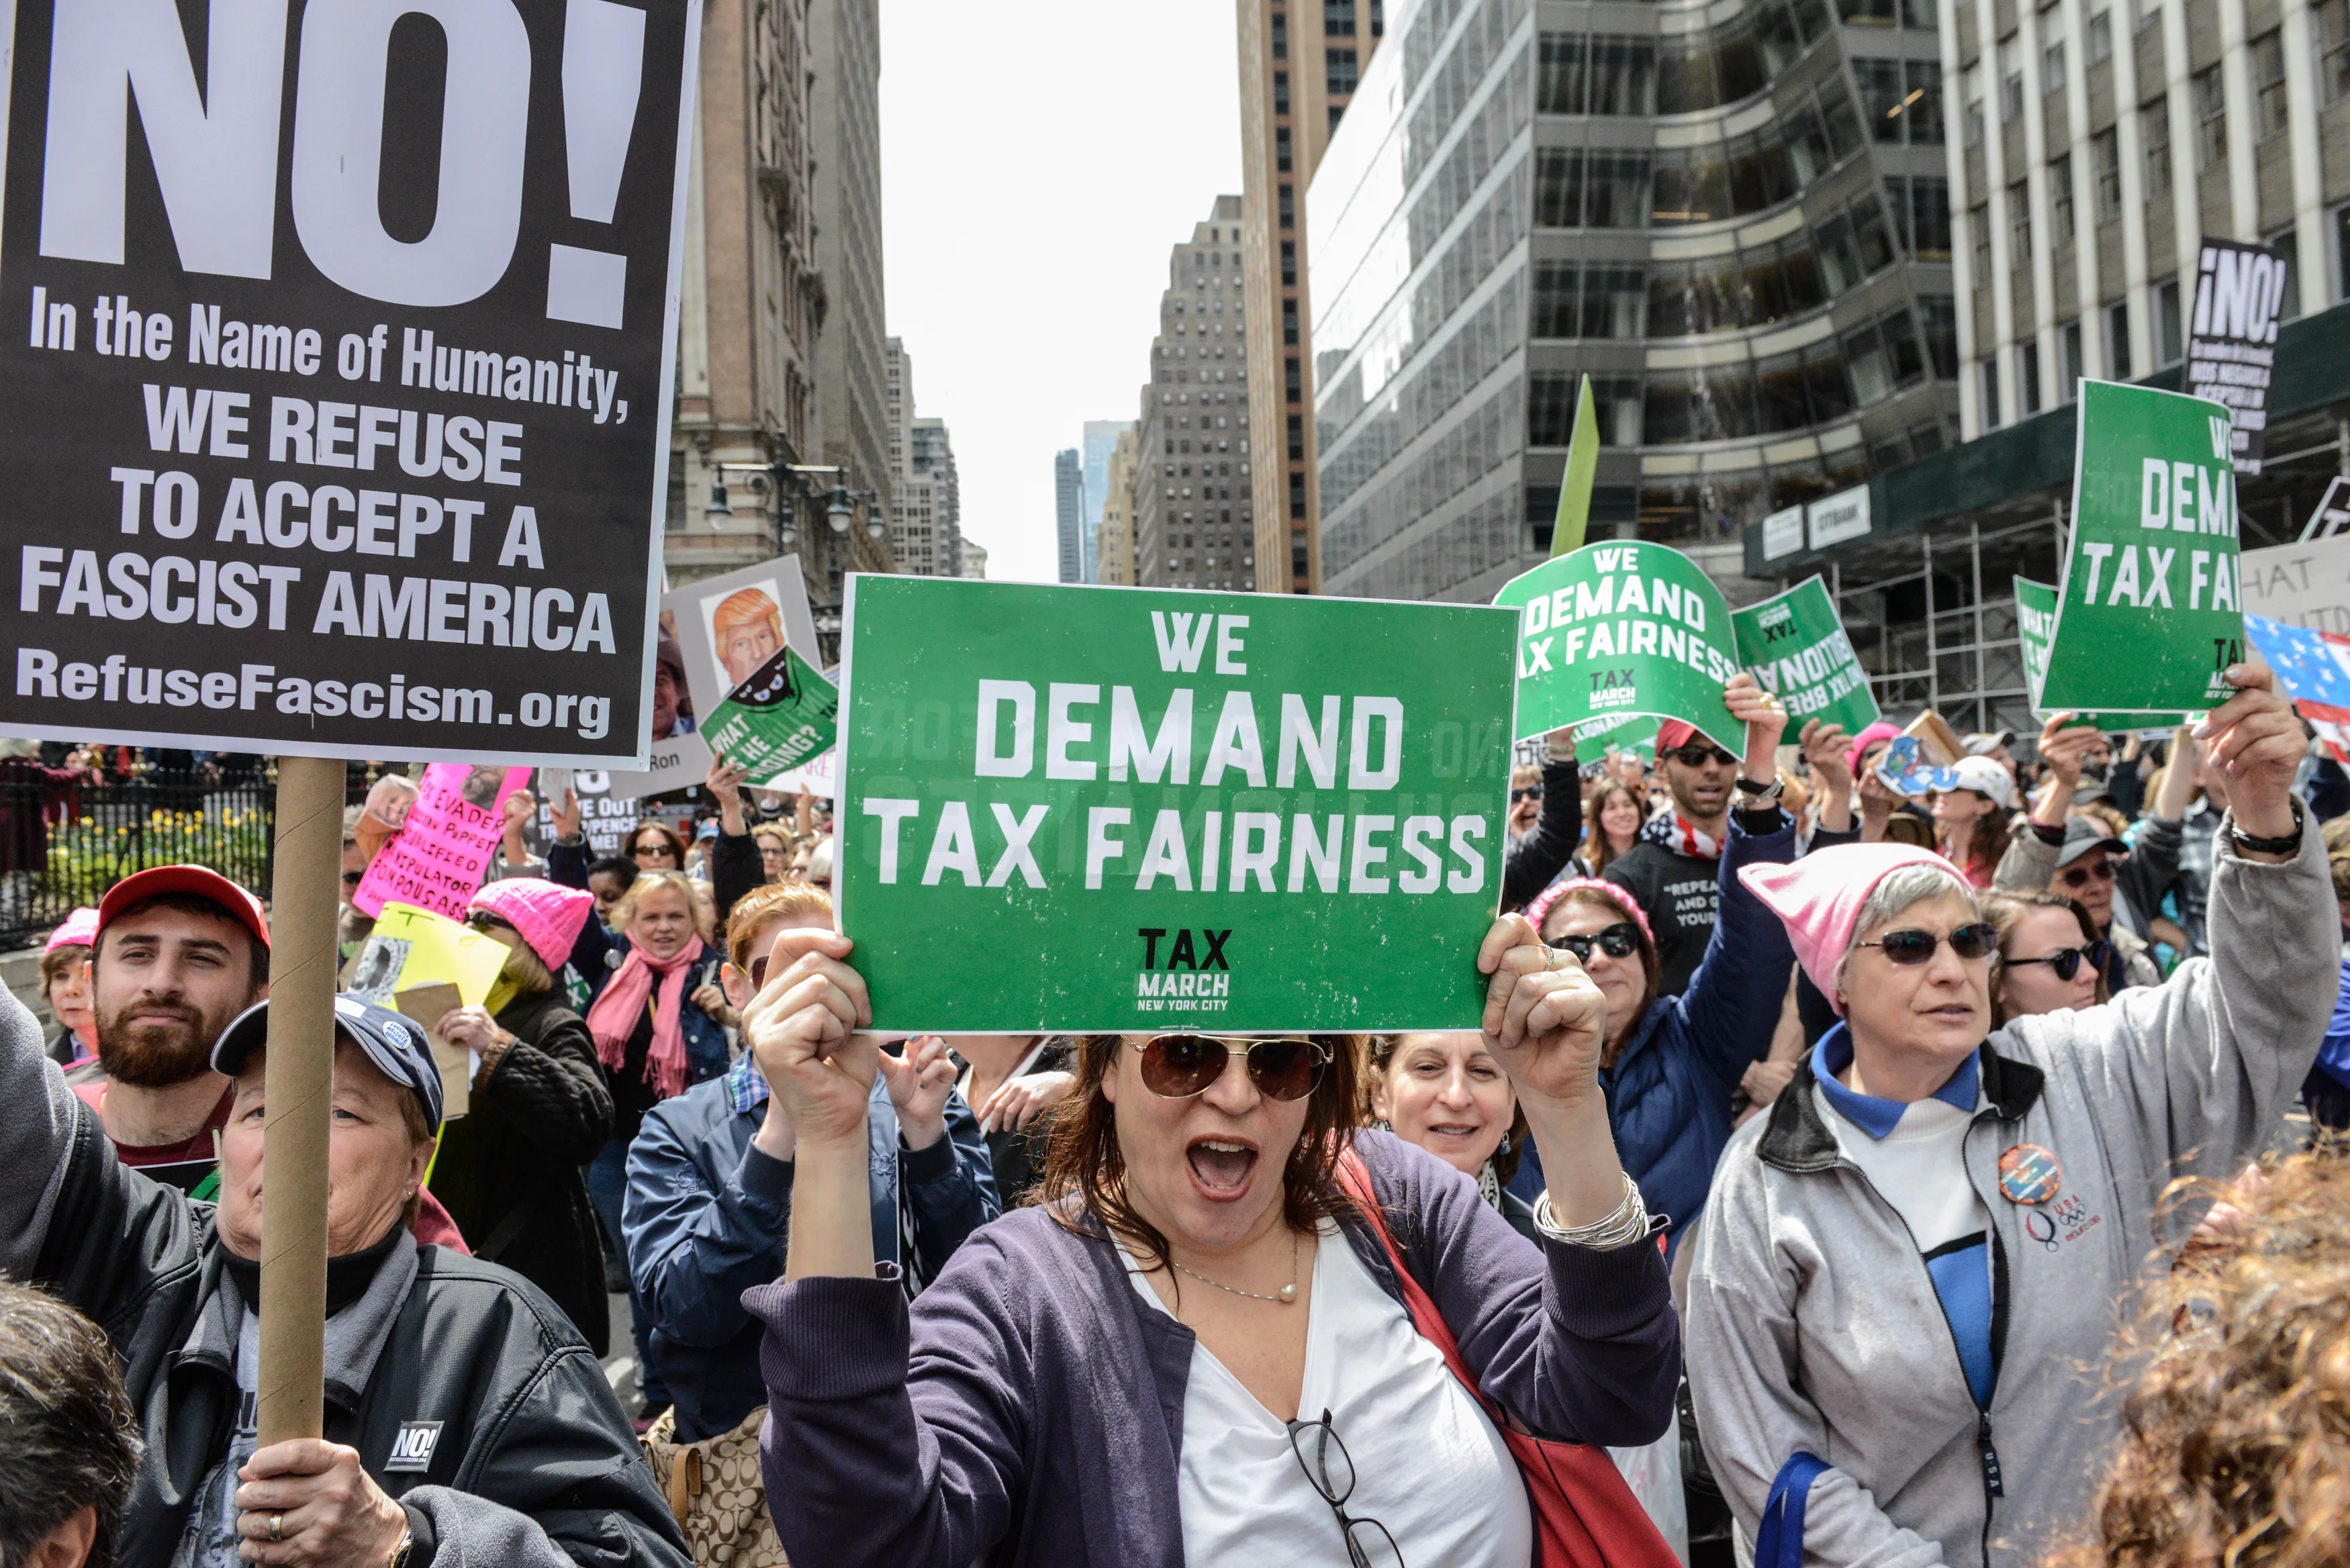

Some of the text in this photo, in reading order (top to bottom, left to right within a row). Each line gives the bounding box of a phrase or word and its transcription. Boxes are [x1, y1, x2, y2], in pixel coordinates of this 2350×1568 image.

[39, 0, 646, 330] NO!
[2193, 246, 2286, 344] ¡NO!
[30, 287, 628, 424] In the Name of Humanity,
[143, 385, 523, 487] WE REFUSE
[111, 467, 545, 570] TO ACCEPT A
[2141, 457, 2237, 538] DEM
[1593, 548, 1639, 573] WE
[2082, 542, 2175, 608] TAX
[20, 545, 617, 654] FASCIST AMERICA
[1524, 575, 1705, 637] DEMAND
[1151, 611, 1250, 675] WE
[16, 648, 611, 740] RefuseFascism.org
[1590, 669, 1635, 691] TAX
[1590, 687, 1636, 705] MARCH
[1780, 683, 1830, 717] BRE
[710, 713, 751, 754] WHAT
[740, 734, 771, 761] HE
[975, 679, 1404, 791] DEMAND
[435, 789, 505, 836] EVADER
[598, 796, 637, 818] OUT
[445, 822, 496, 853] PUPPET
[862, 797, 1048, 889] TAX
[1084, 807, 1487, 895] FAIRNESS
[1675, 896, 1707, 912] AND
[1138, 928, 1233, 971] TAX
[1137, 999, 1229, 1011] NEW YORK CITY
[1138, 973, 1229, 997] MARCH
[2053, 1195, 2079, 1215] USA
[391, 1428, 437, 1457] NO!
